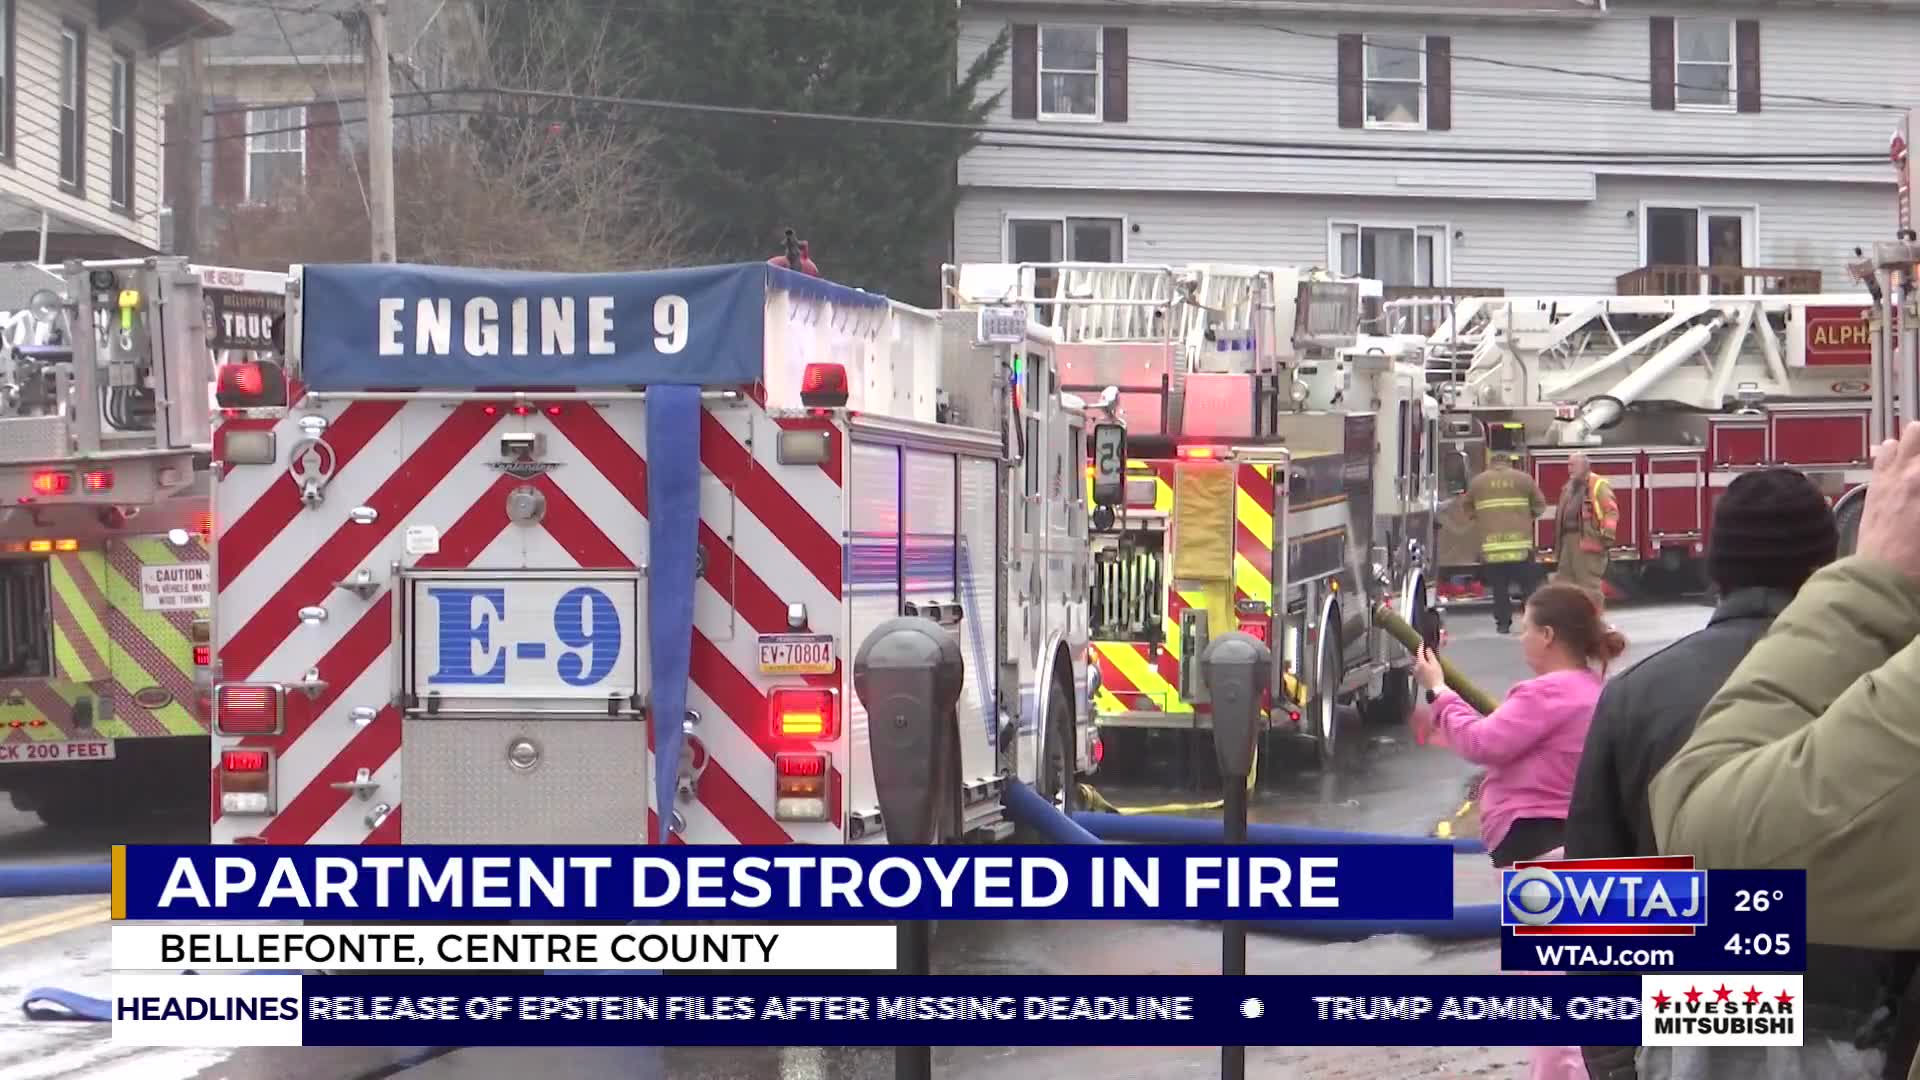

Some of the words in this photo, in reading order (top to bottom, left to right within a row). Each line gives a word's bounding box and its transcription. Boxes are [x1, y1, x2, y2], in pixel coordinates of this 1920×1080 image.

[223, 313, 272, 339] TRUC
[379, 296, 616, 357] ENGINE
[653, 295, 689, 355] 9
[156, 567, 202, 582] CAUTION
[428, 587, 621, 686] E-9
[27, 744, 59, 758] 200
[67, 743, 107, 757] FEET
